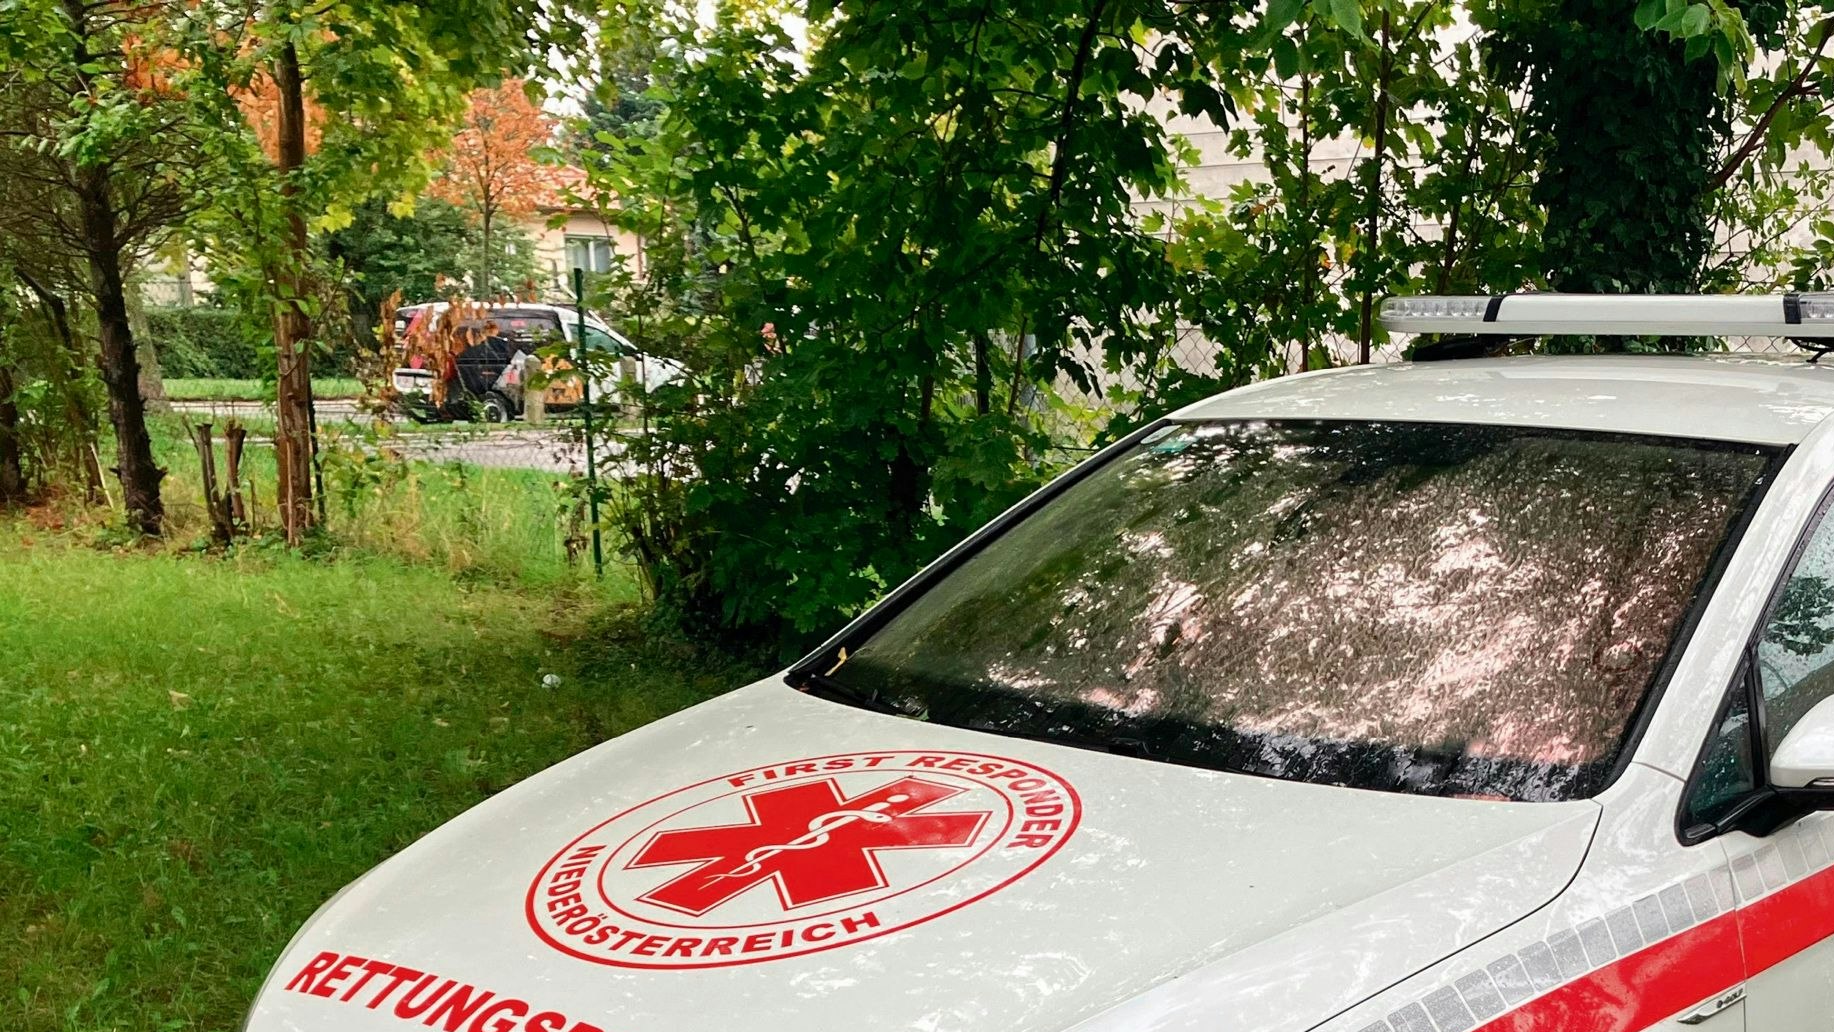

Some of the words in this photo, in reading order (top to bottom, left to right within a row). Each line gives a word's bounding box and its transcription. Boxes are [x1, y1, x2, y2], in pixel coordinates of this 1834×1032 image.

[727, 751, 894, 788] FIRST
[908, 755, 1064, 849] RESPONDER
[547, 845, 881, 958] NIEDERÖSTERREICH
